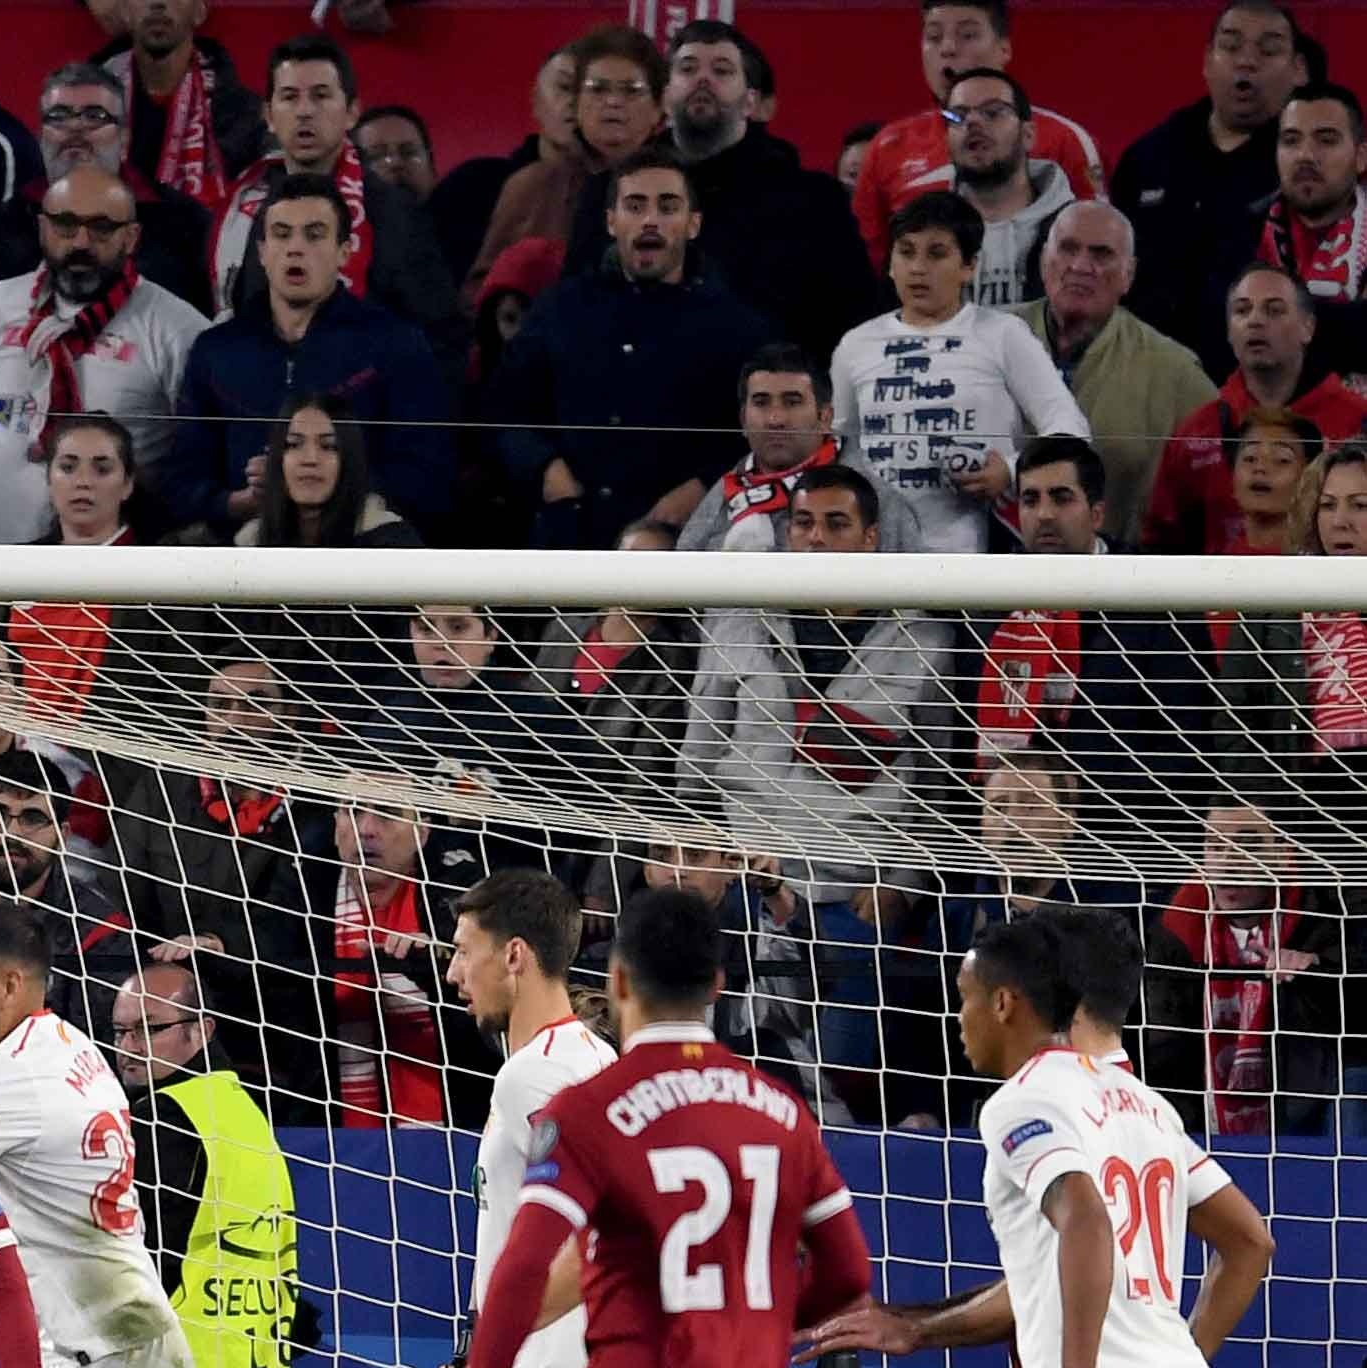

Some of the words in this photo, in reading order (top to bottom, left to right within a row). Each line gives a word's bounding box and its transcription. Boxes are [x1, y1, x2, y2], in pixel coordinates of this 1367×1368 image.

[80, 1108, 141, 1236] 2
[646, 1144, 781, 1313] 21
[1100, 1155, 1179, 1305] 20
